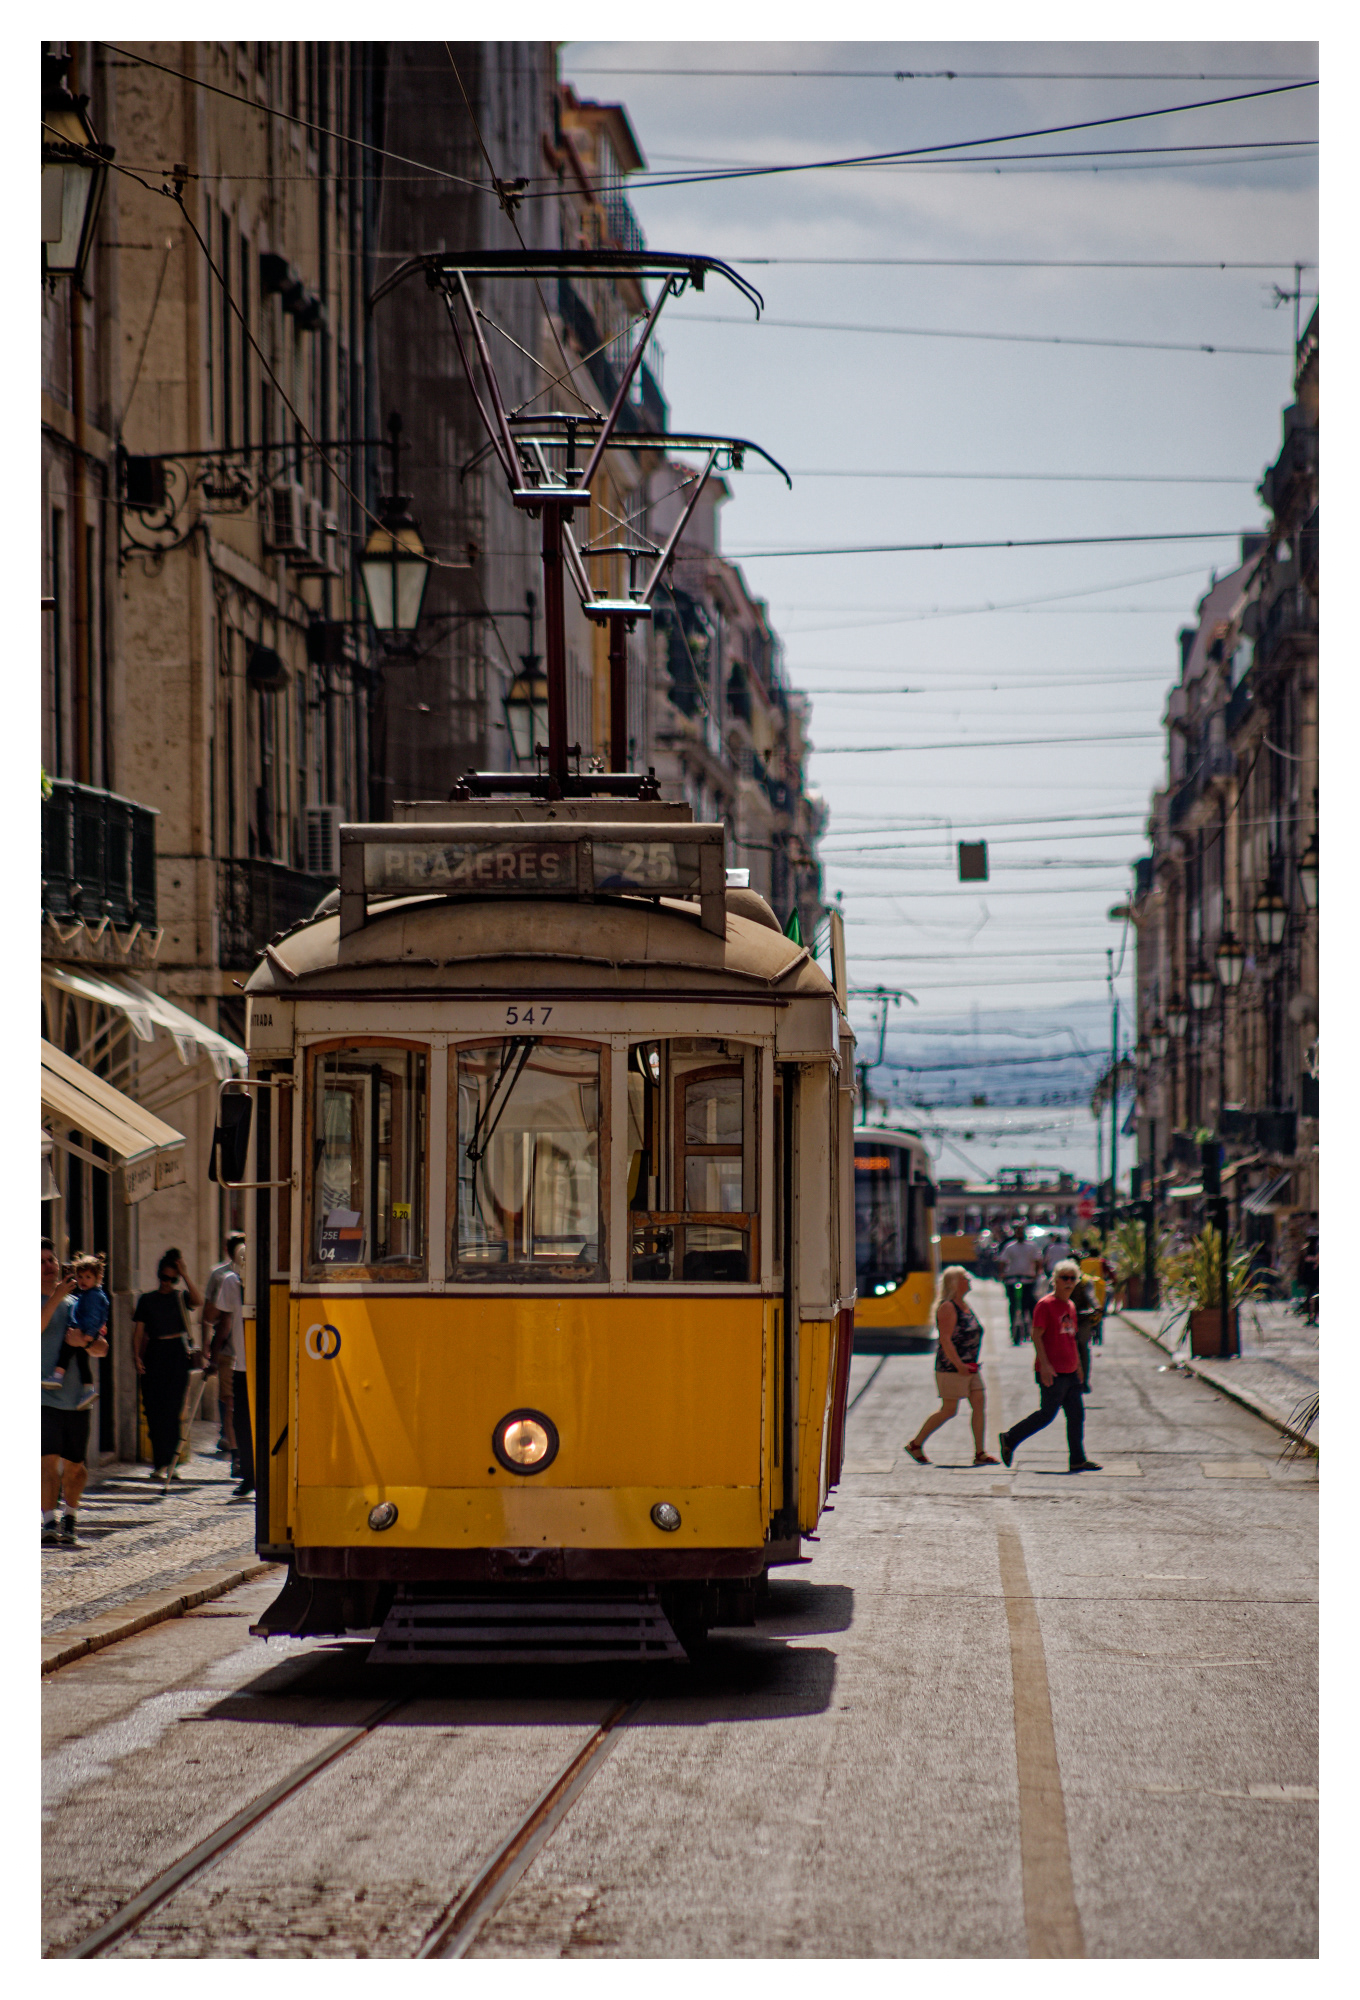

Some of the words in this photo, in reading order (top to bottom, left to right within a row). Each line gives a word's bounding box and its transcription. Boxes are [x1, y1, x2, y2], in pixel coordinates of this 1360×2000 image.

[386, 852, 560, 879] PRAZERES
[620, 842, 673, 882] 25
[506, 1006, 553, 1026] 547
[322, 1231, 339, 1241] 25E
[319, 1247, 336, 1261] 04
